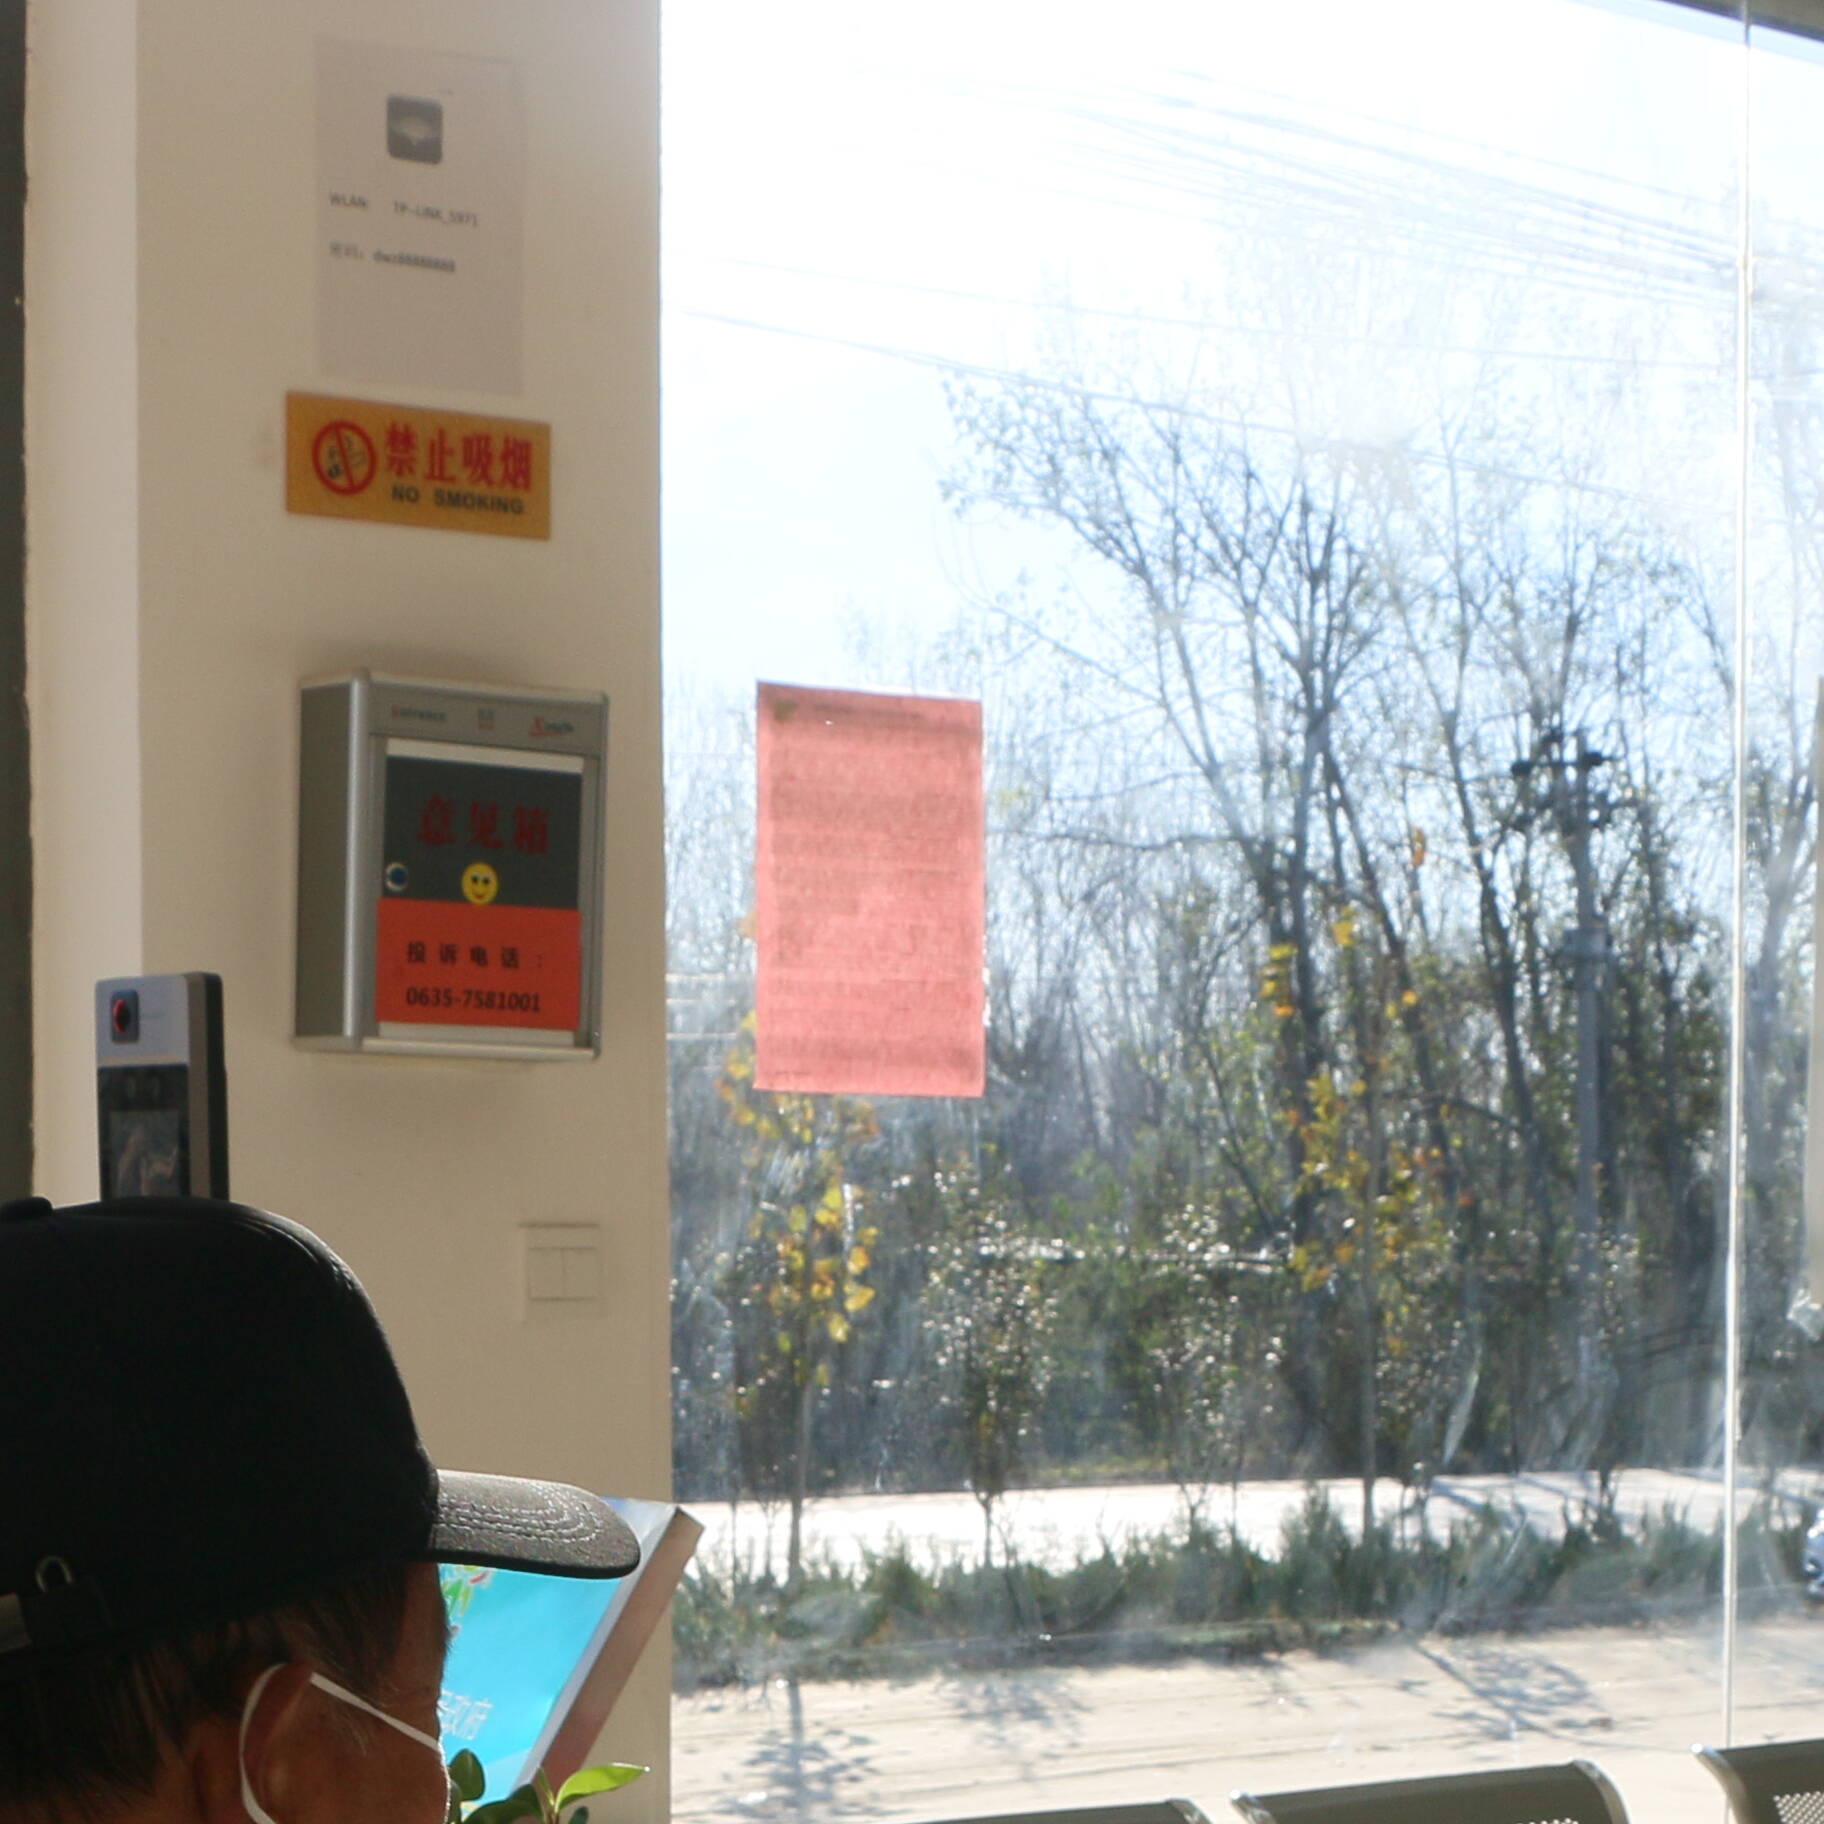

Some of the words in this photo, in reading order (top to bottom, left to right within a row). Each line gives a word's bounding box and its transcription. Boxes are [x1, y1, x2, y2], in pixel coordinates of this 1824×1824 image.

[385, 421, 532, 492] 禁止吸烟
[392, 484, 420, 504] NO
[433, 488, 524, 515] SMOKING
[416, 793, 552, 855] 意见箱
[406, 988, 541, 1012] 0635-7581001
